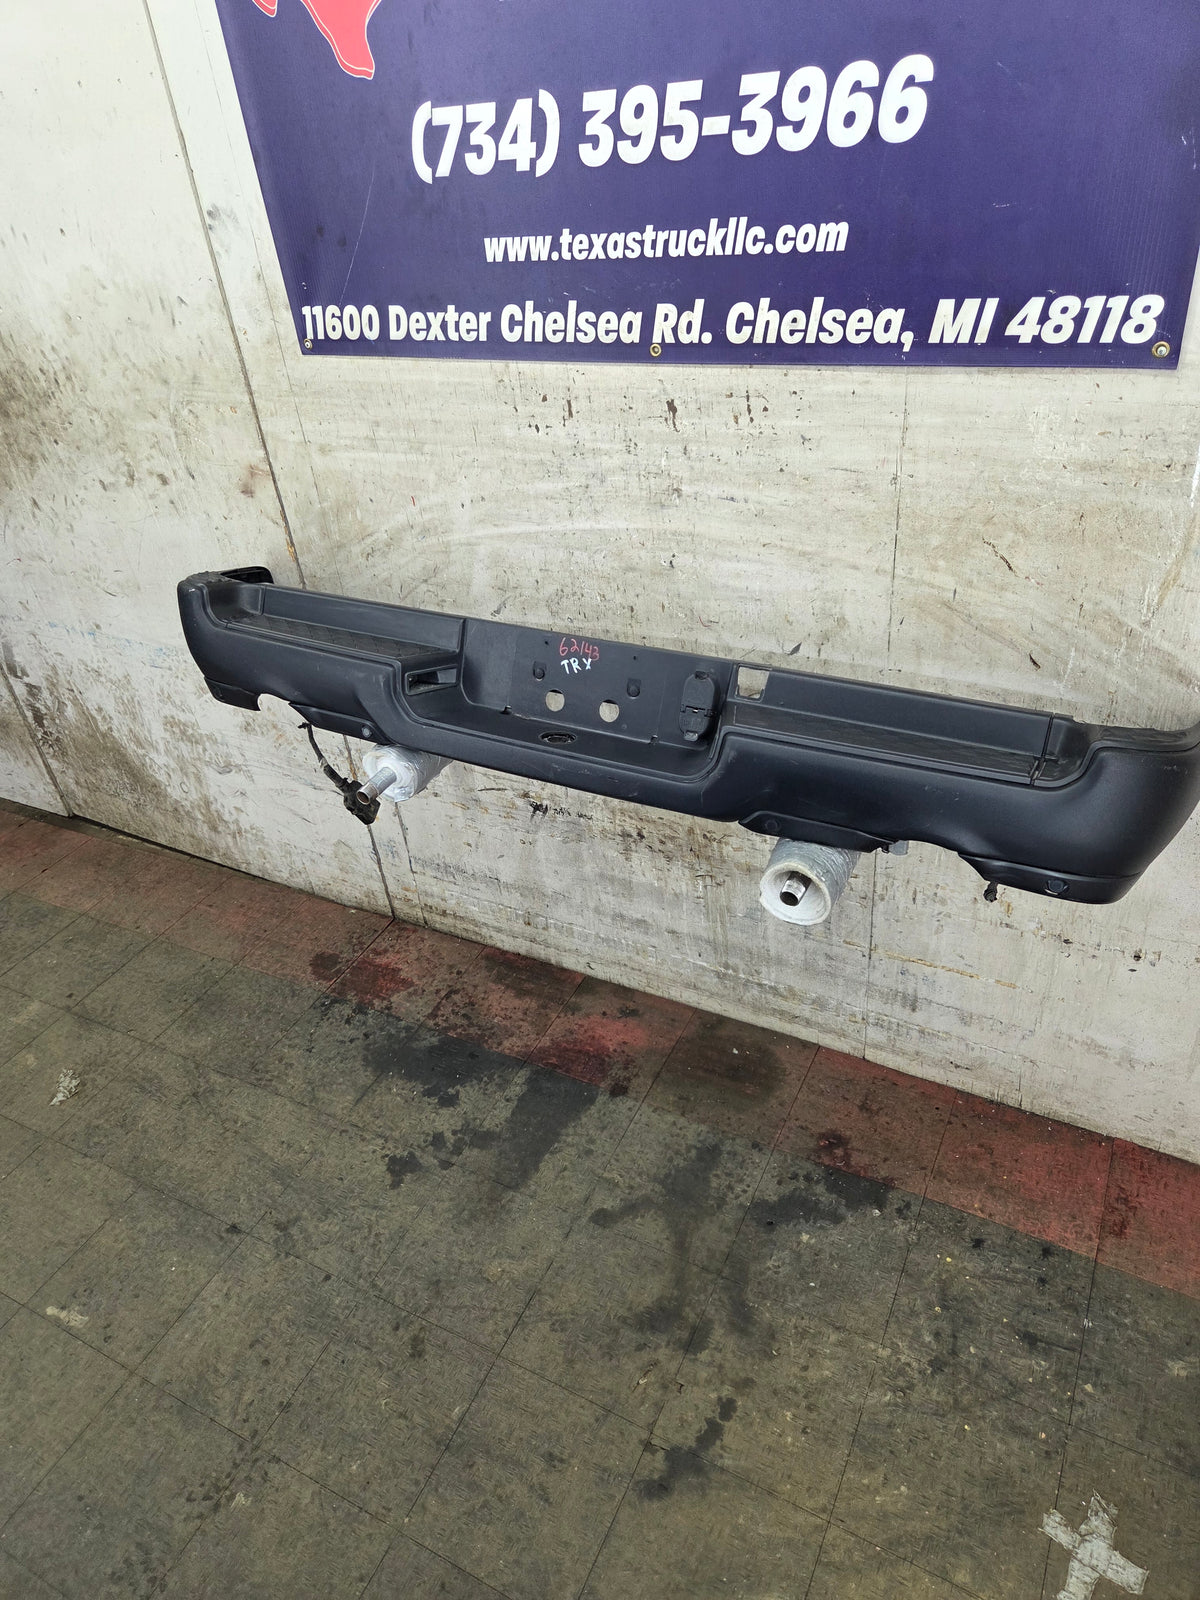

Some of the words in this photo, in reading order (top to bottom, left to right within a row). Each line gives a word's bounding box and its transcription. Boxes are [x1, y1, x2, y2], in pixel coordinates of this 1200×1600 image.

[411, 88, 561, 184] (734)
[578, 53, 935, 168] 395-3966
[484, 216, 850, 264] www.texastruckllc.com
[301, 304, 380, 341] 11600
[388, 304, 492, 342] Dexter
[500, 299, 642, 344] Chelsea
[651, 303, 713, 344] Rd.
[725, 297, 915, 353] Chelsea,
[927, 297, 1000, 344] MI
[1004, 293, 1166, 345] 48118
[559, 637, 600, 661] 62143
[560, 657, 593, 674] TRX
